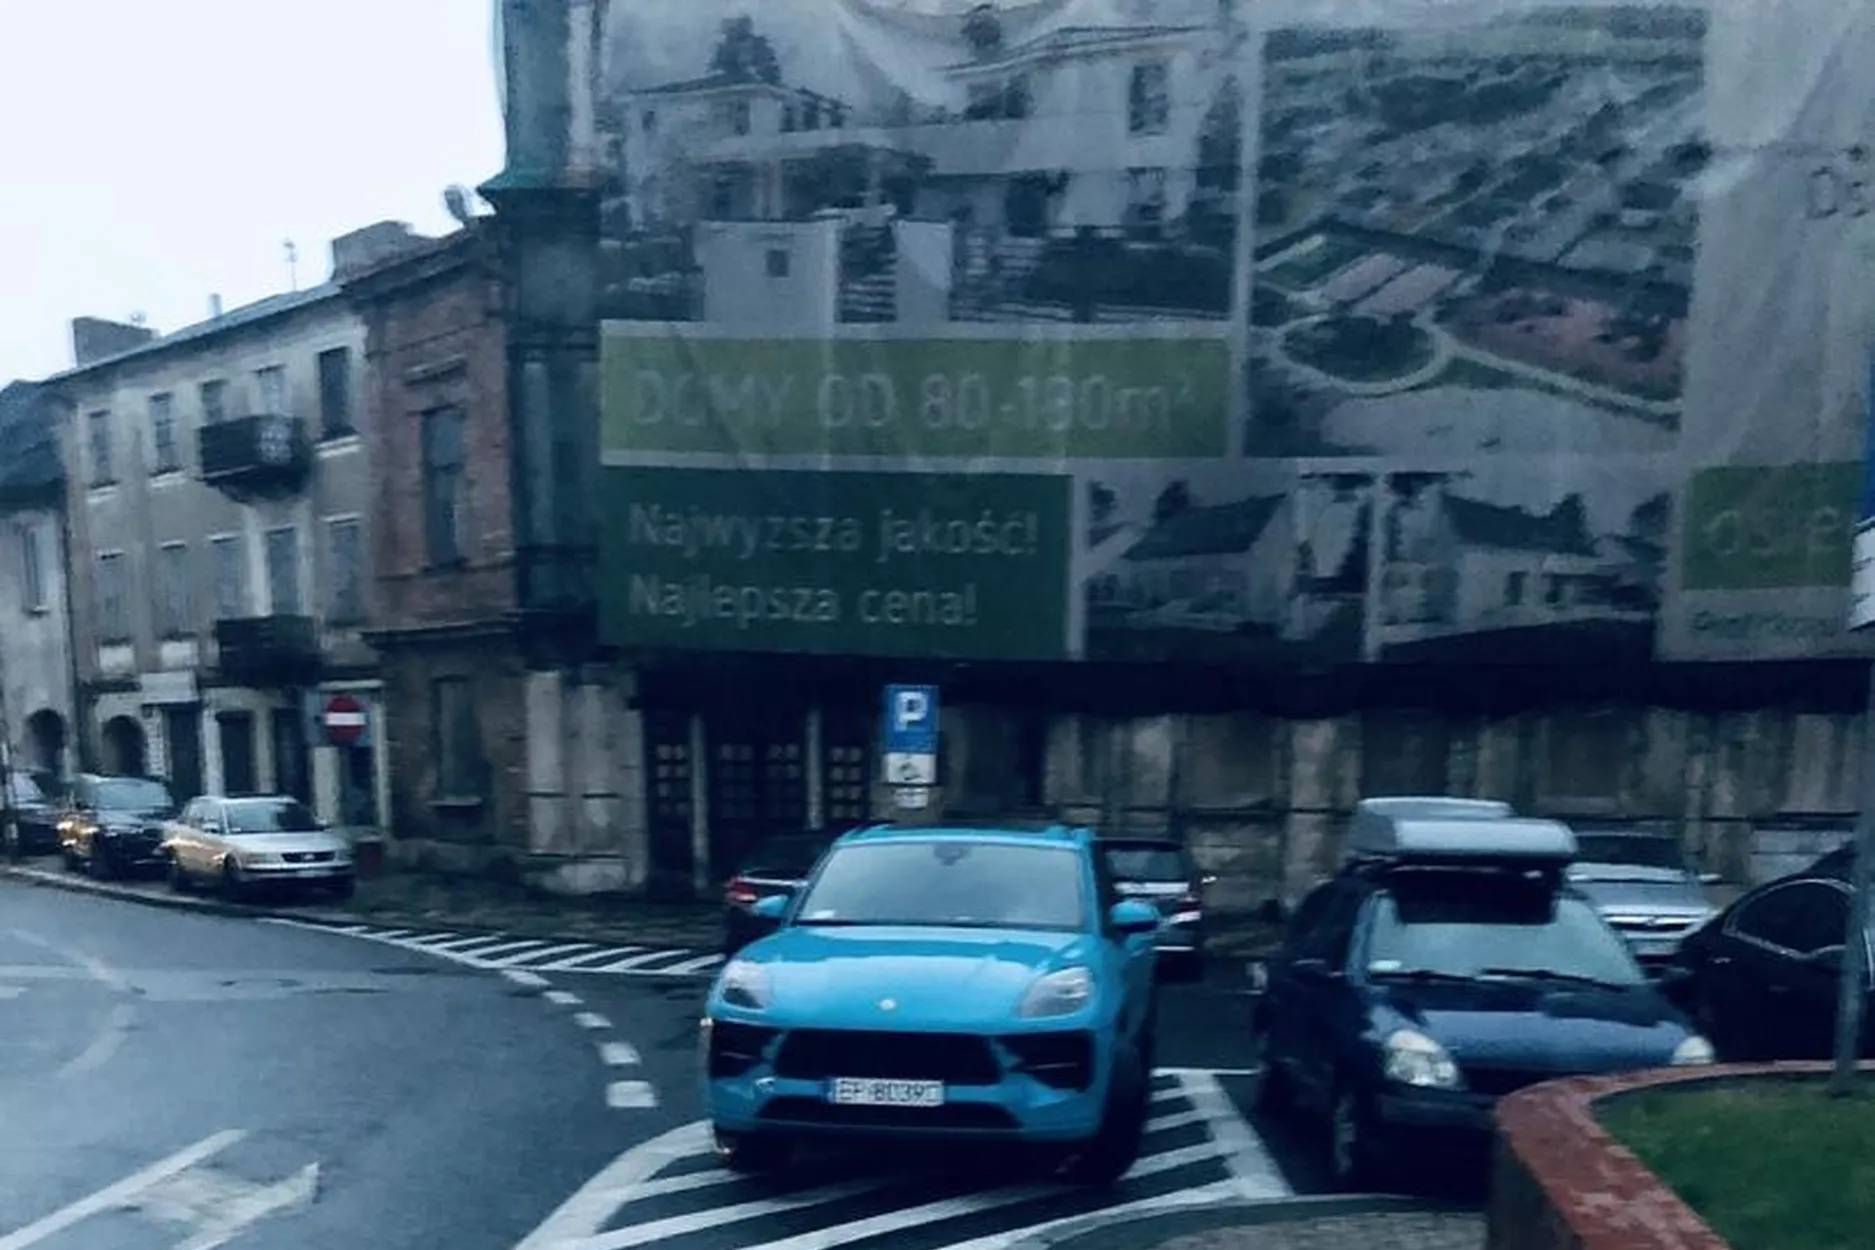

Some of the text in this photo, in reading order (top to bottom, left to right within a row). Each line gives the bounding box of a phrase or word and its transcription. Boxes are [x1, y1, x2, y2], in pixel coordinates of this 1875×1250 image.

[818, 372, 897, 430] OD
[628, 572, 981, 630] Najlepsza cena!
[895, 692, 928, 732] P
